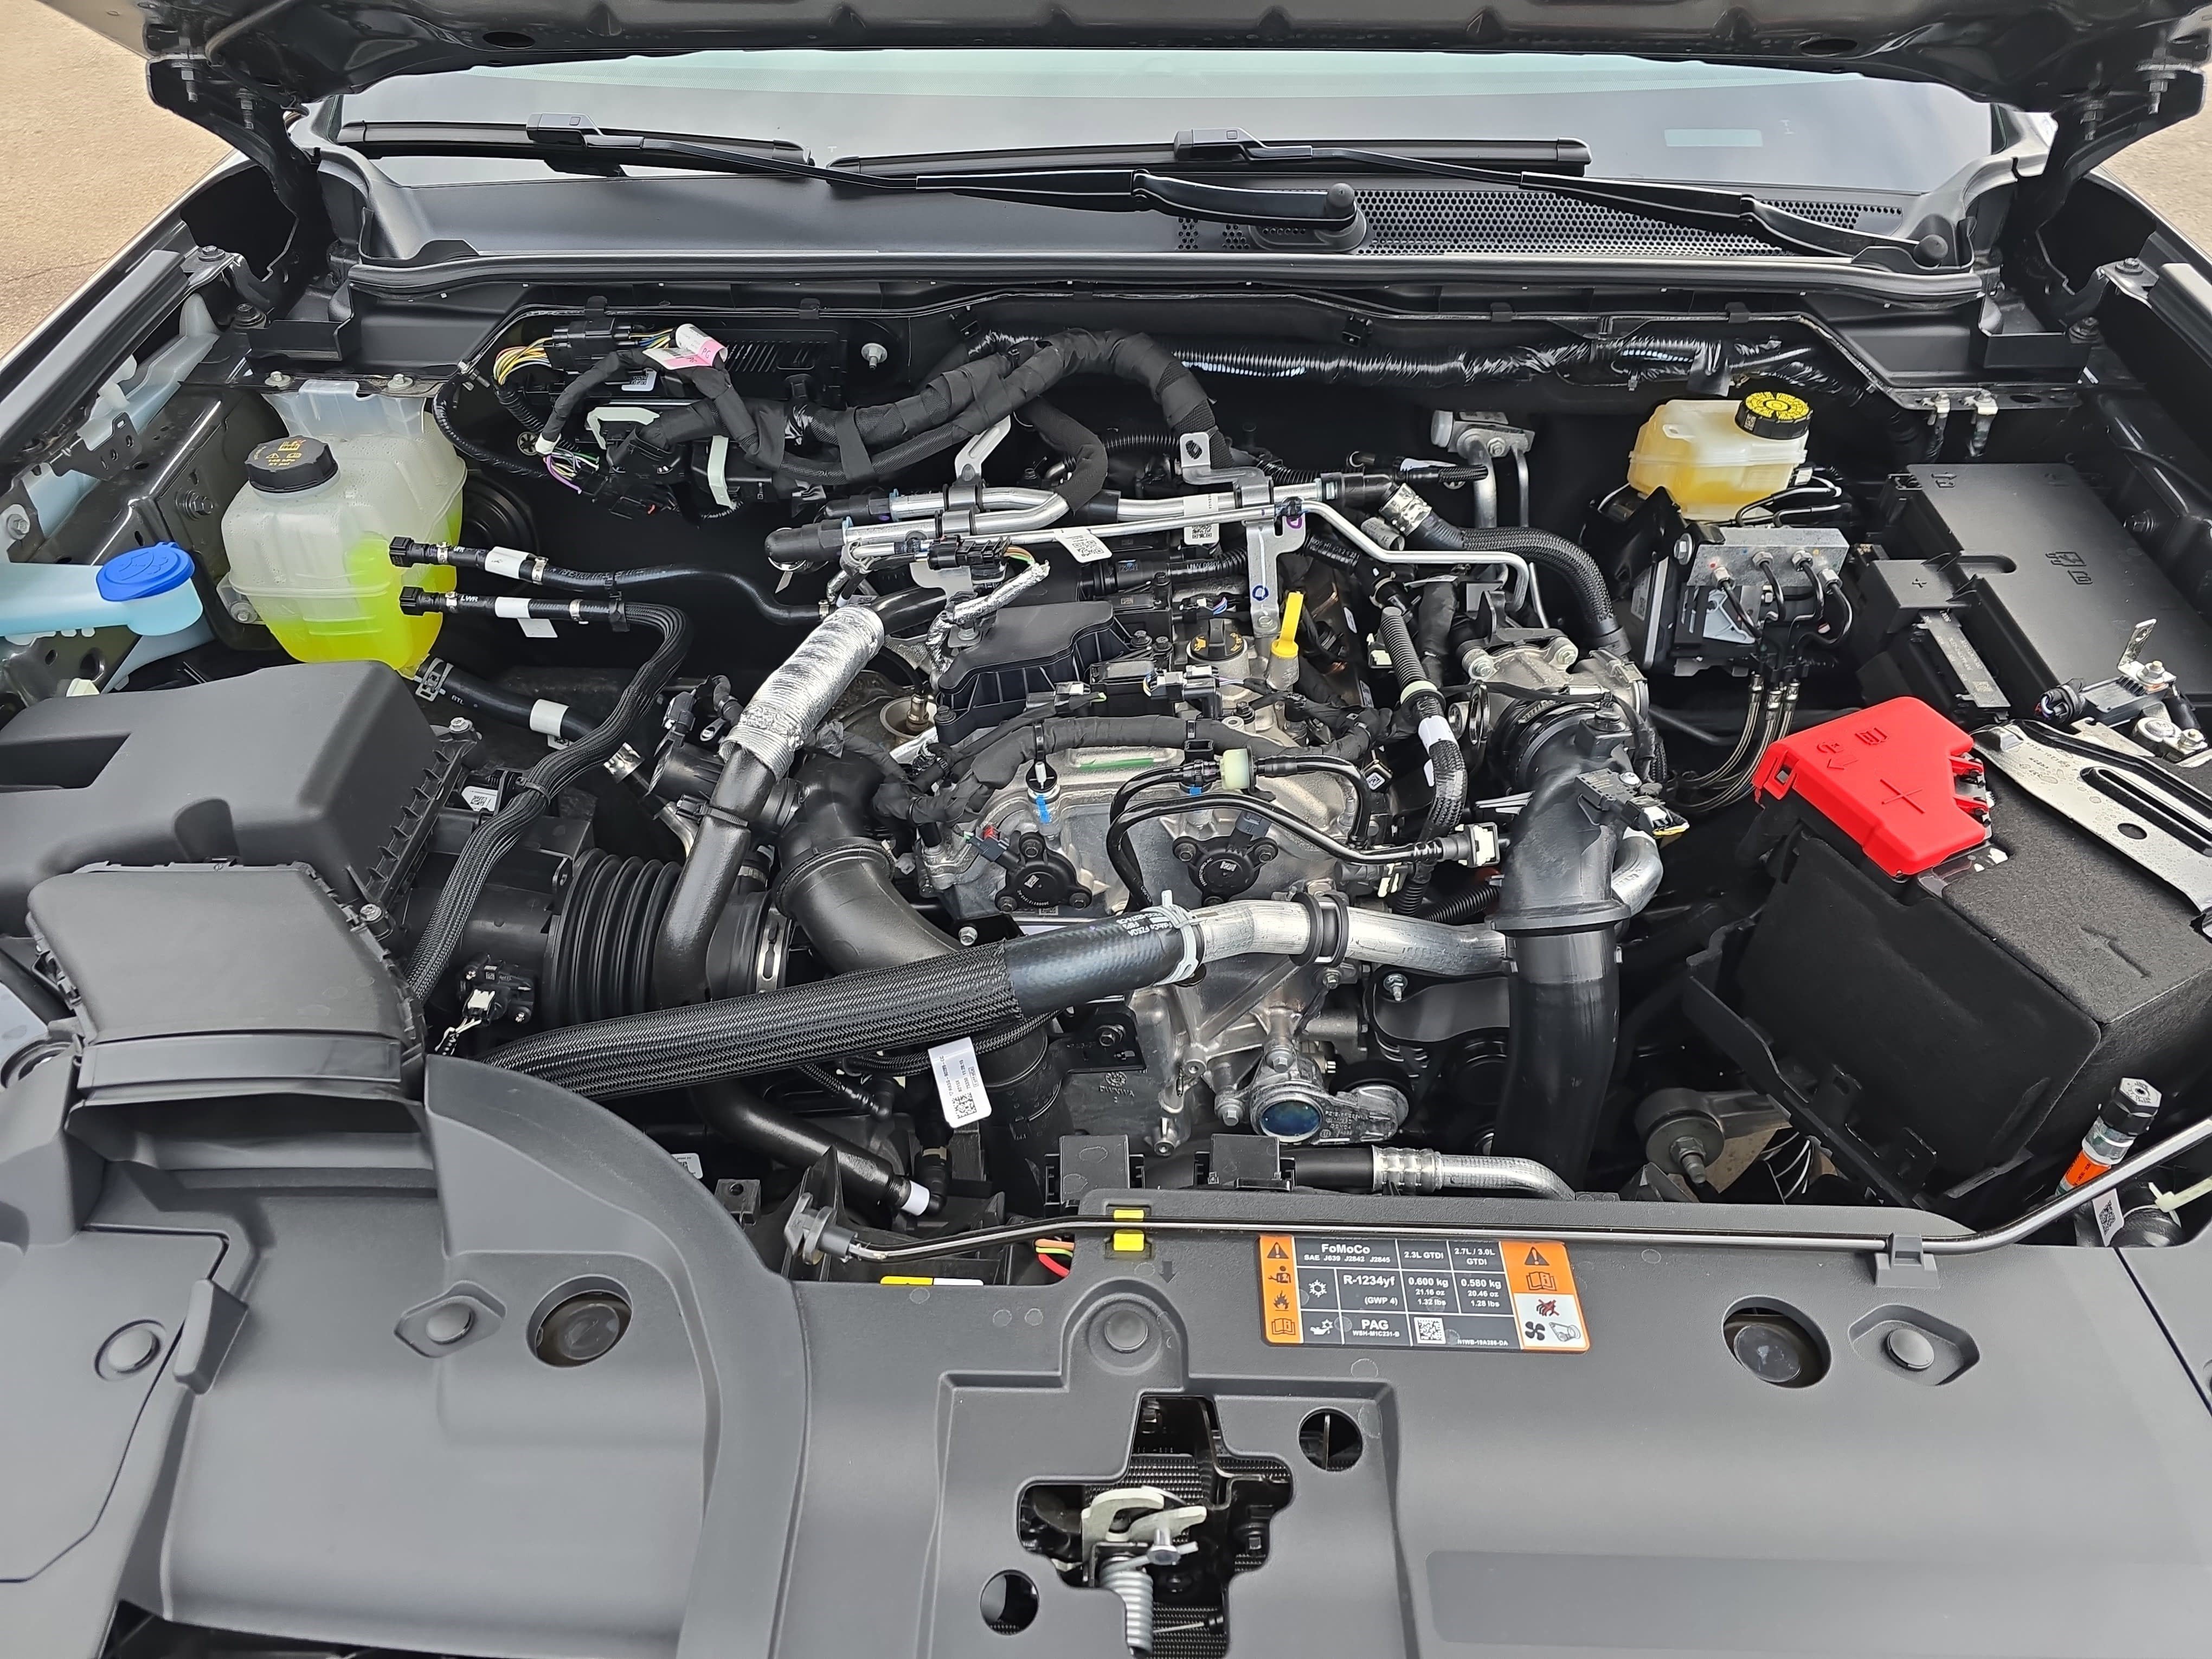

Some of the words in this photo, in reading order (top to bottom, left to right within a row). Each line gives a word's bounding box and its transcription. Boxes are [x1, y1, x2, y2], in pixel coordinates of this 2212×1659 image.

[1321, 1243, 1371, 1254] FoMoCo
[1343, 1275, 1396, 1288] R-1234yf
[1408, 1277, 1434, 1285] 0.600
[1436, 1278, 1449, 1288] kg
[1461, 1278, 1486, 1287] 0.580
[1489, 1279, 1501, 1289] kg
[1364, 1296, 1388, 1306] (GWP
[1390, 1296, 1398, 1306] 4)
[1361, 1319, 1389, 1330] PAG
